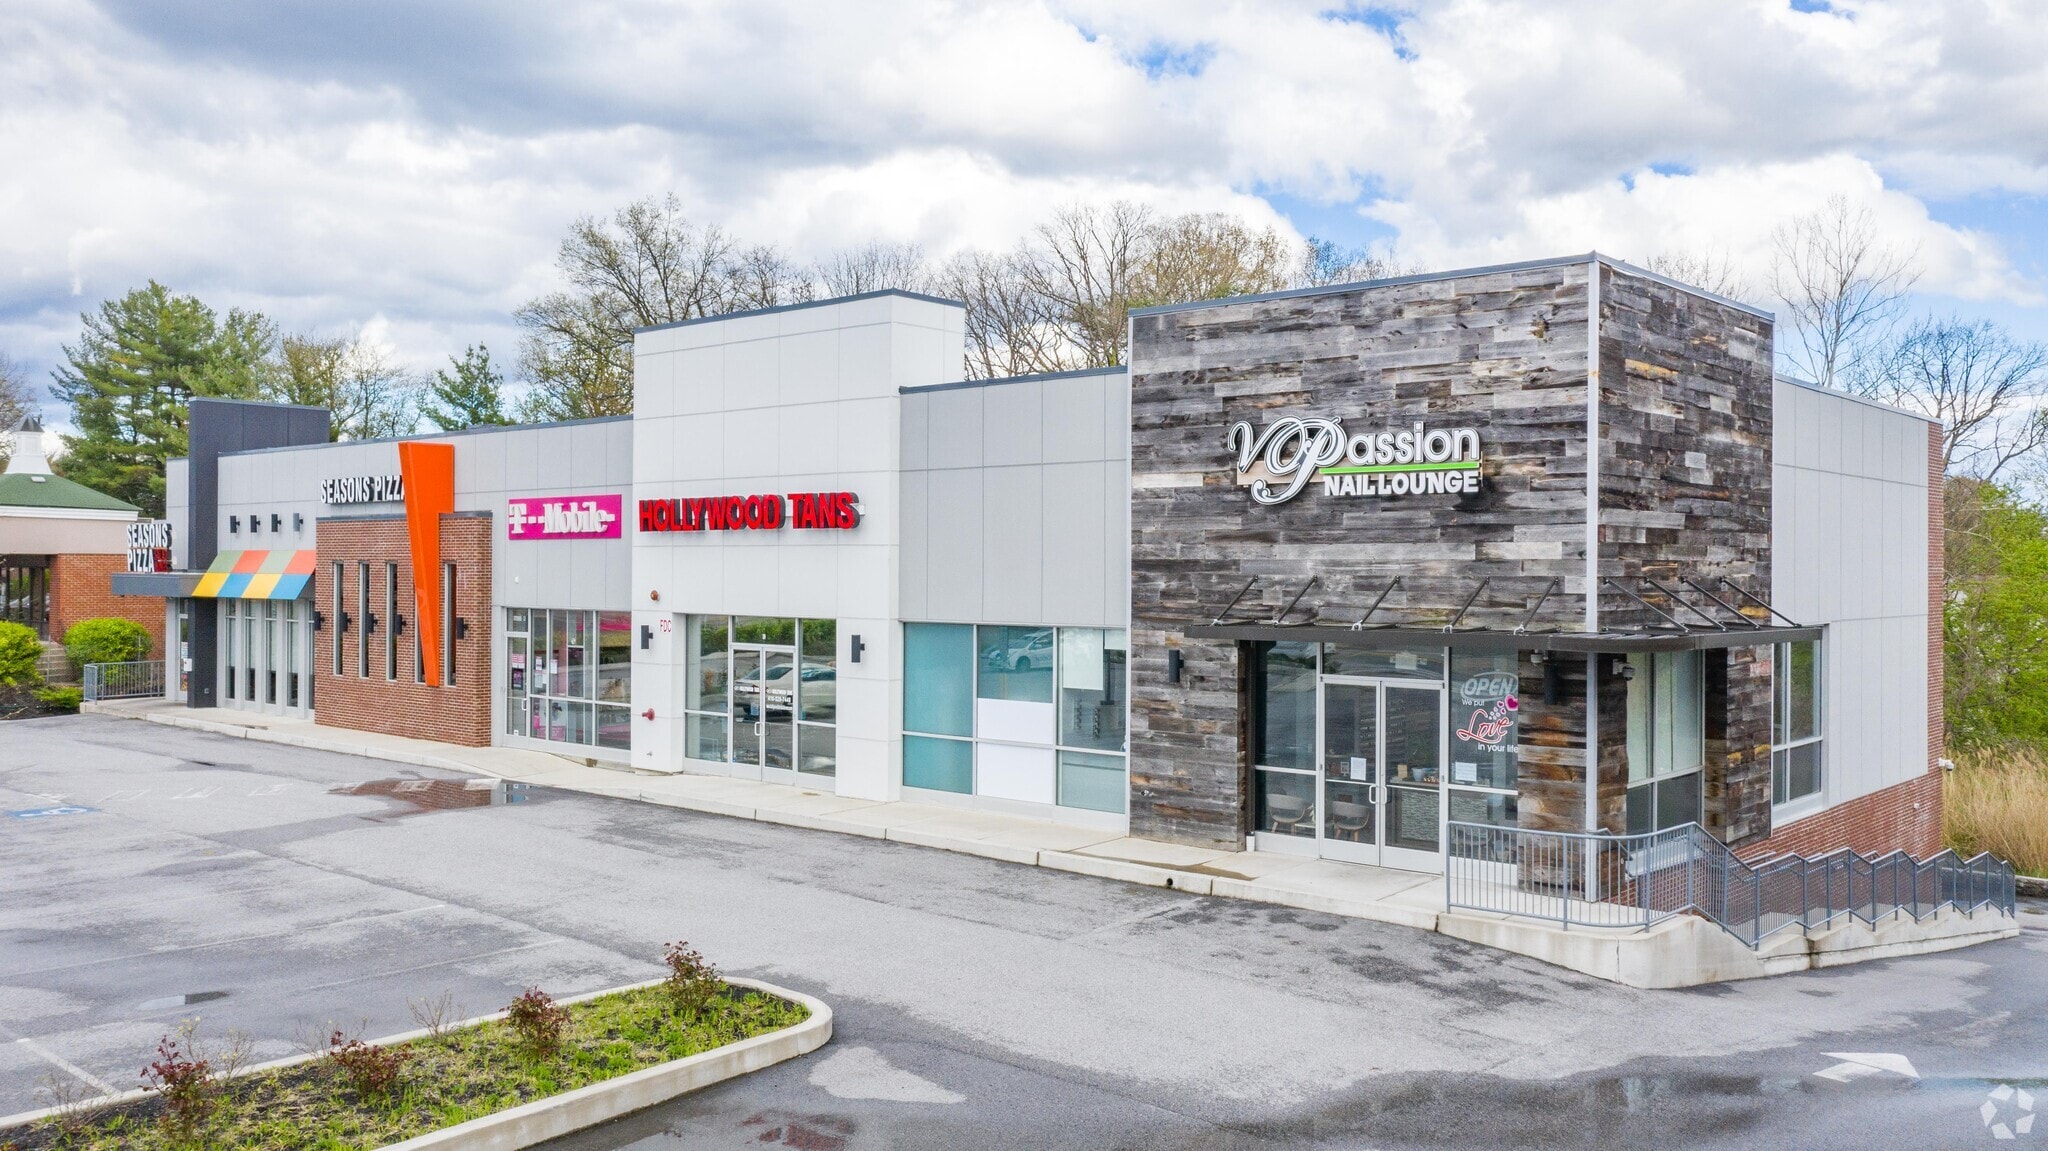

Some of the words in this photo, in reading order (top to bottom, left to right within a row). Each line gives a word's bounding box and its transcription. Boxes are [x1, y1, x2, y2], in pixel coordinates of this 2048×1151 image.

[320, 476, 371, 503] SEASONS
[374, 475, 405, 501] PIZZ
[1323, 475, 1375, 496] NAIL
[1377, 470, 1479, 495] LOUNGE
[639, 494, 784, 532] HOLLYWOOD
[787, 491, 857, 530] TANS
[127, 523, 169, 548] SEASONS
[127, 549, 155, 573] PIZZA
[660, 619, 671, 632] FDC
[1464, 678, 1513, 696] OPEN
[1456, 709, 1513, 744] Love
[1477, 743, 1485, 751] in
[1487, 744, 1505, 753] your
